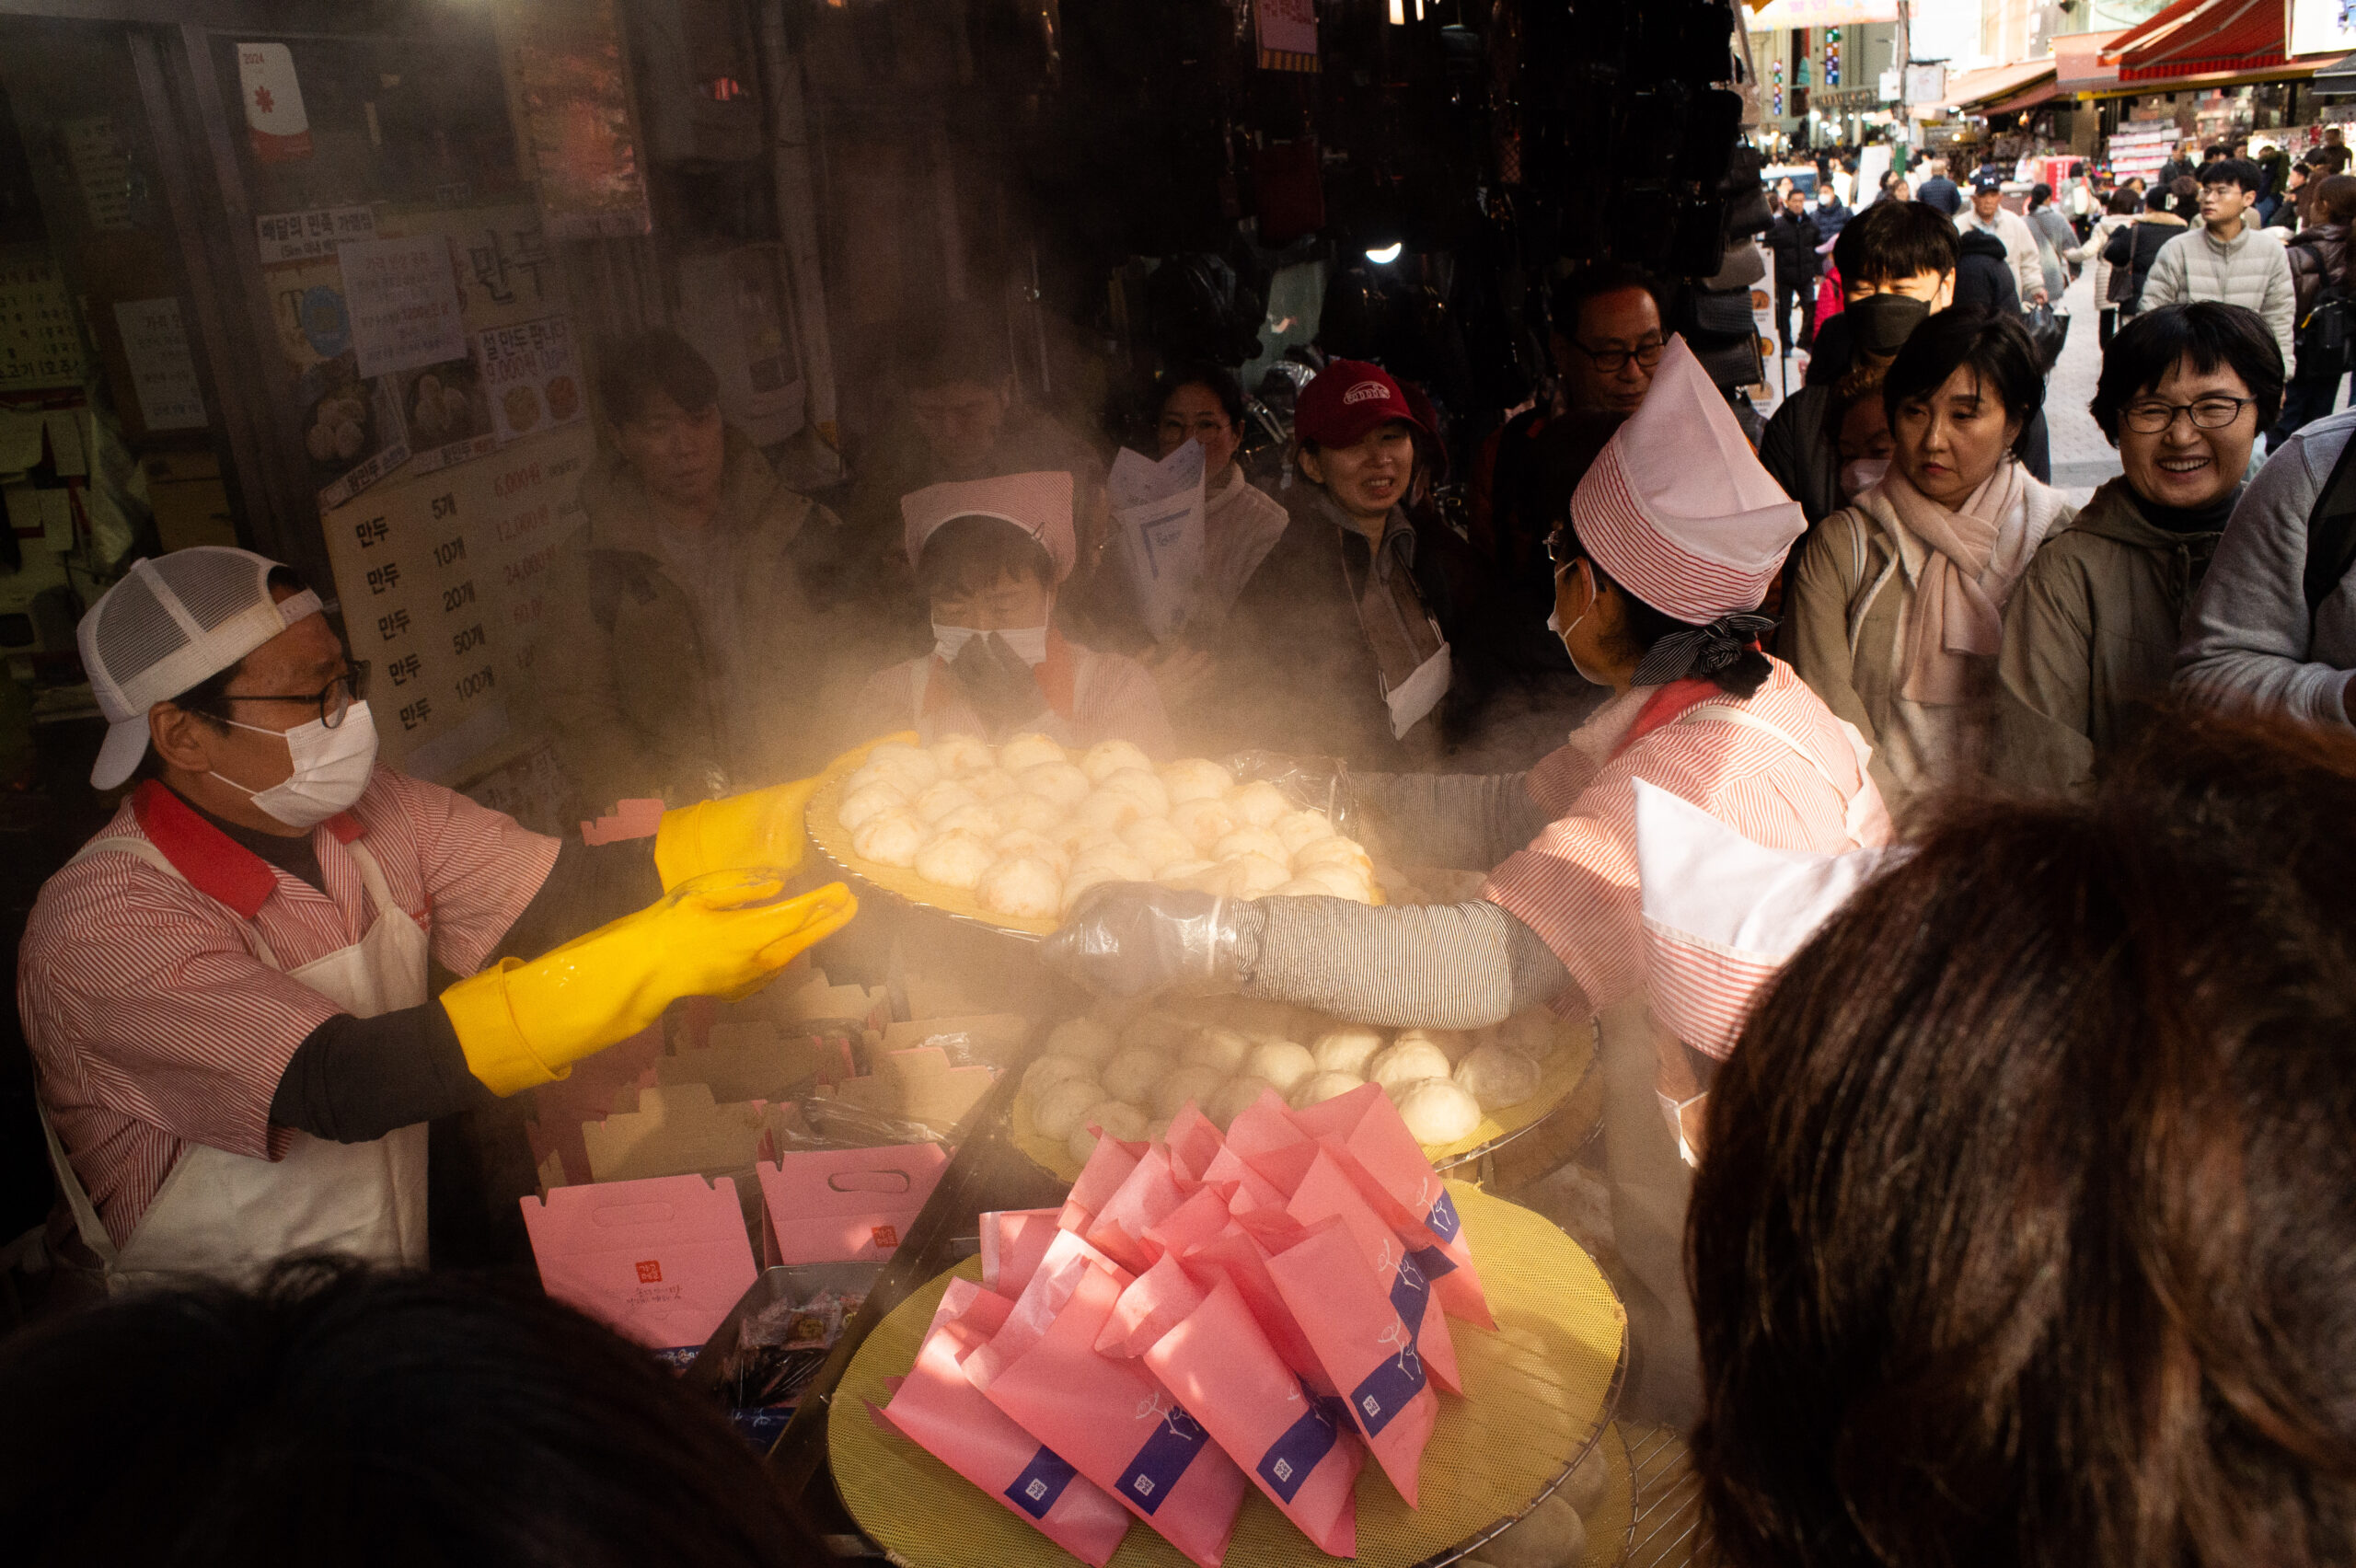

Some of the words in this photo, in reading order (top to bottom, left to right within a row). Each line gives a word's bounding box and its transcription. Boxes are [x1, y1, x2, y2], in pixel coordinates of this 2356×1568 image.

[243, 53, 264, 64] 2024
[499, 328, 528, 357] 만두
[355, 516, 389, 548] 만두
[432, 492, 457, 520] 5개
[494, 462, 543, 500] 6,000원
[366, 562, 400, 595] 만두
[433, 536, 467, 568] 10개
[378, 608, 410, 641] 만두
[443, 580, 476, 613] 20개
[388, 653, 422, 686] 만두
[453, 623, 486, 656] 50개
[399, 698, 433, 731] 만두
[455, 664, 495, 702] 100개
